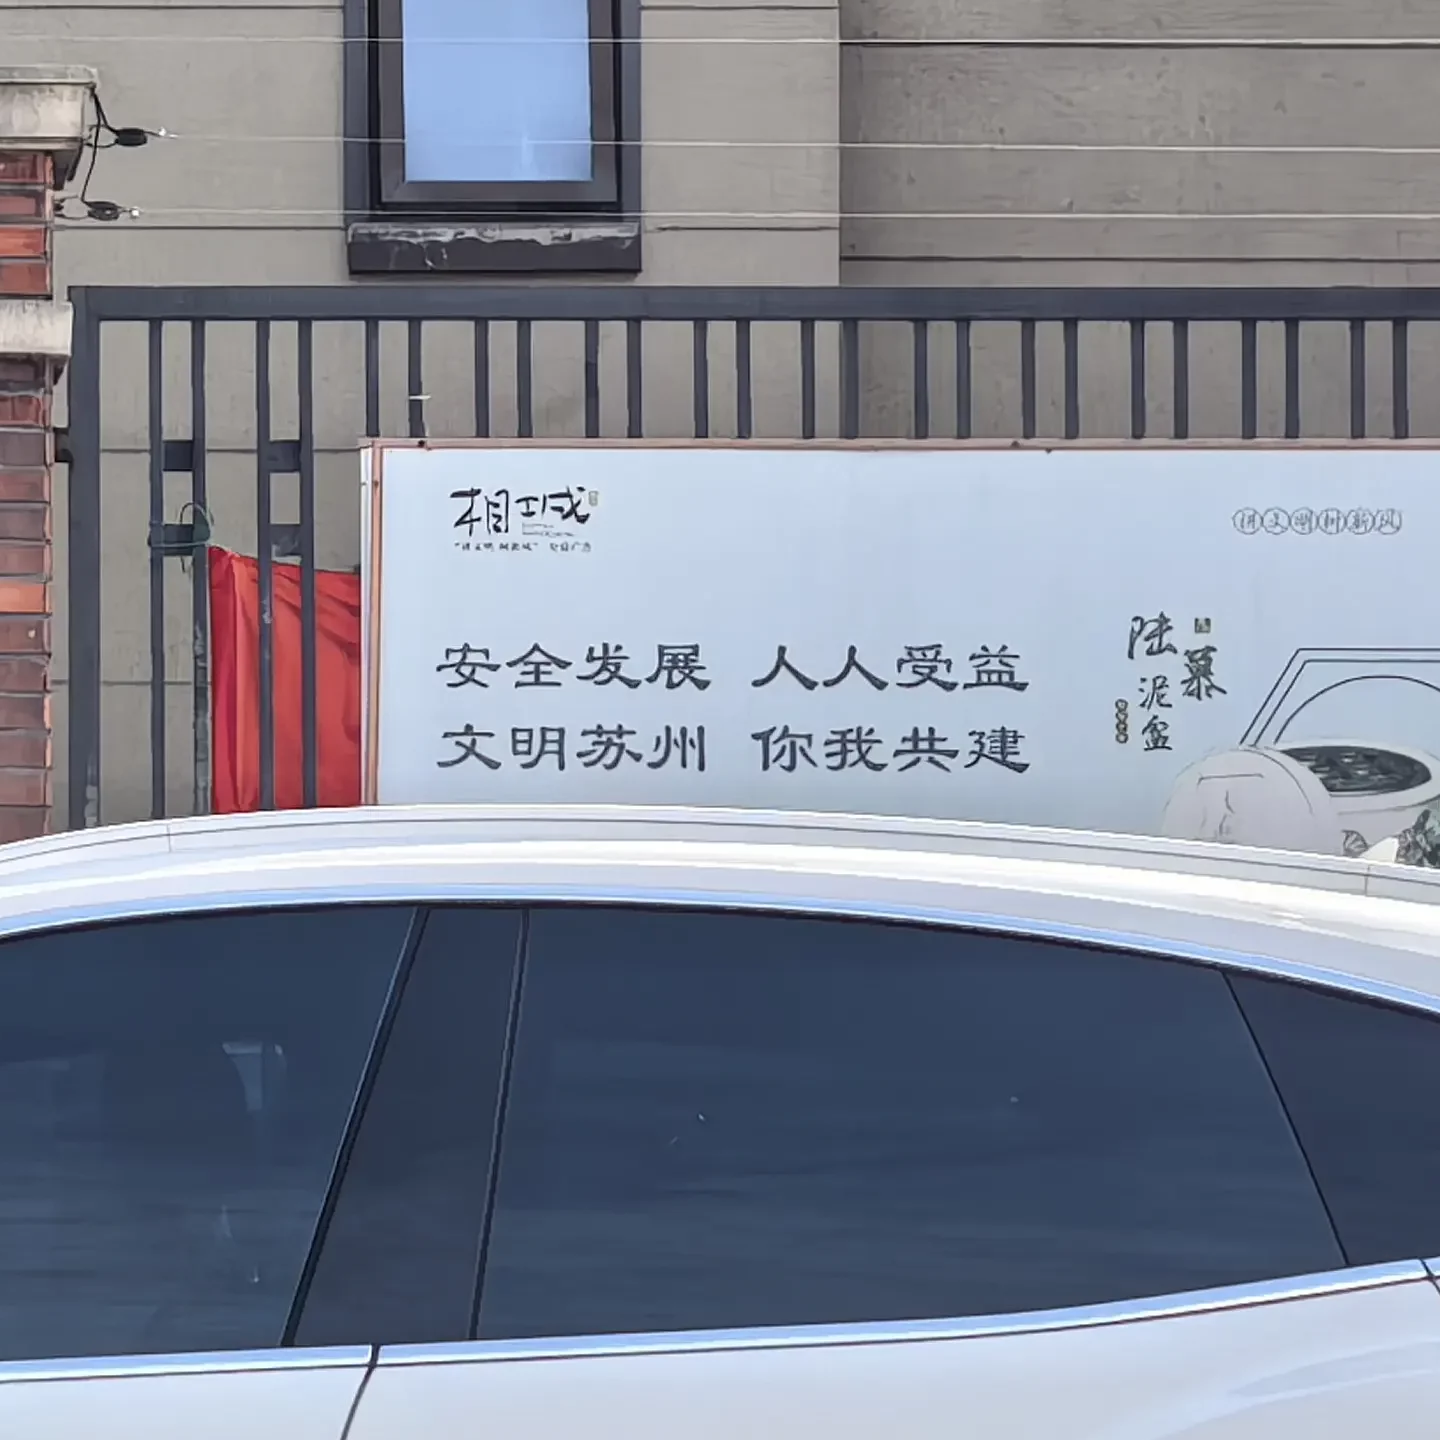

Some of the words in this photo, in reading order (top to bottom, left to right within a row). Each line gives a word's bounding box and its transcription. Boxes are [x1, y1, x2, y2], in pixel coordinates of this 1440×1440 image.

[435, 643, 713, 691] 安全发展
[751, 643, 1030, 692] 人人受益
[435, 723, 709, 771] 文明苏州
[751, 724, 1031, 773] 你我共建
